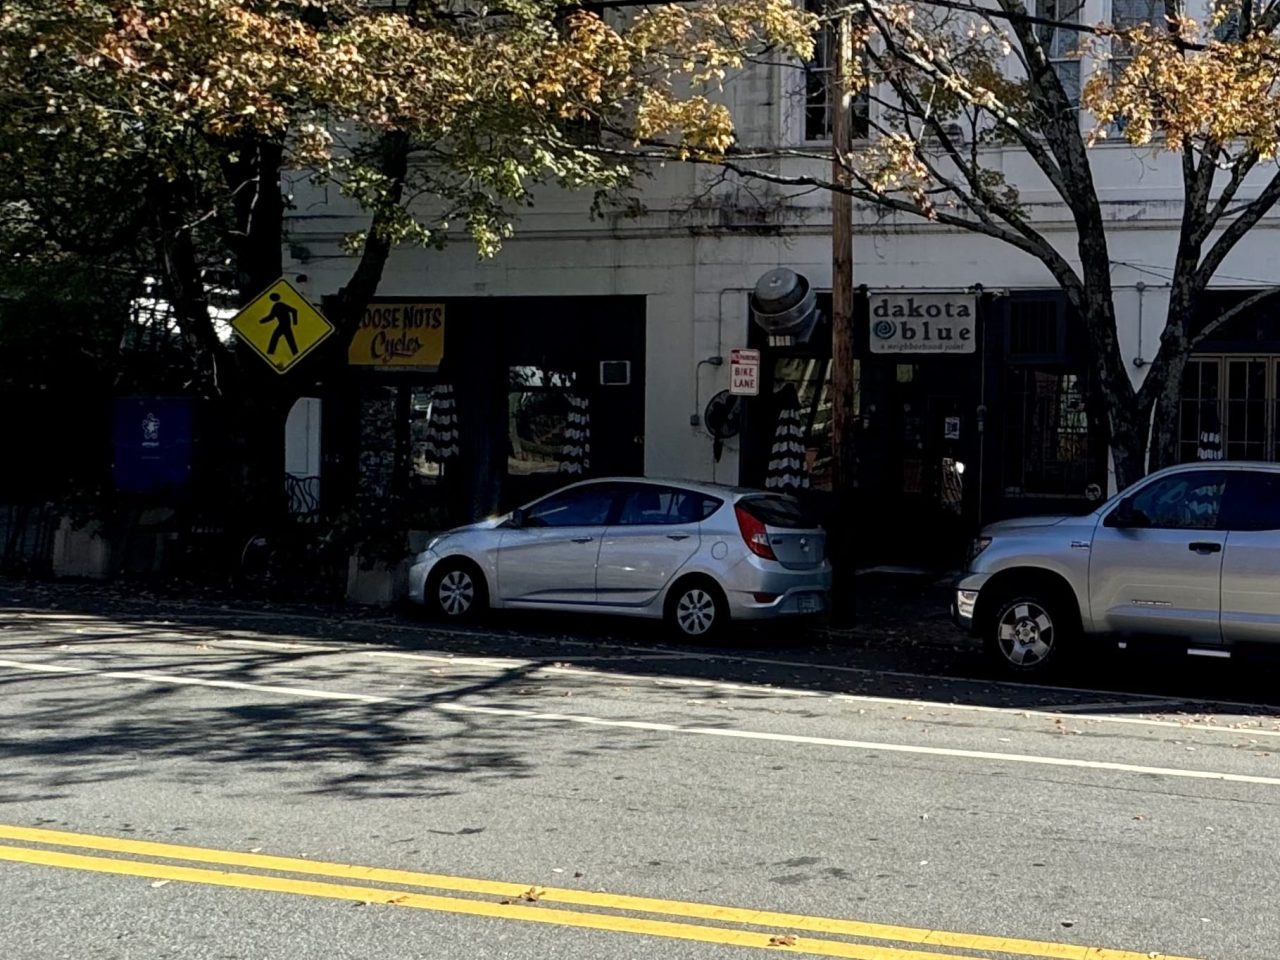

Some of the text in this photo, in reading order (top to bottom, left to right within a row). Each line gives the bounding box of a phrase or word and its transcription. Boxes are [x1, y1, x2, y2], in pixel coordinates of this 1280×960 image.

[873, 297, 971, 318] dakota
[361, 306, 442, 330] OOSE NUTS
[900, 321, 971, 341] blue
[370, 330, 425, 363] Cycles
[887, 343, 943, 352] neighborhood
[944, 343, 965, 352] joint
[734, 367, 754, 377] BIKE
[734, 379, 755, 389] LANE
